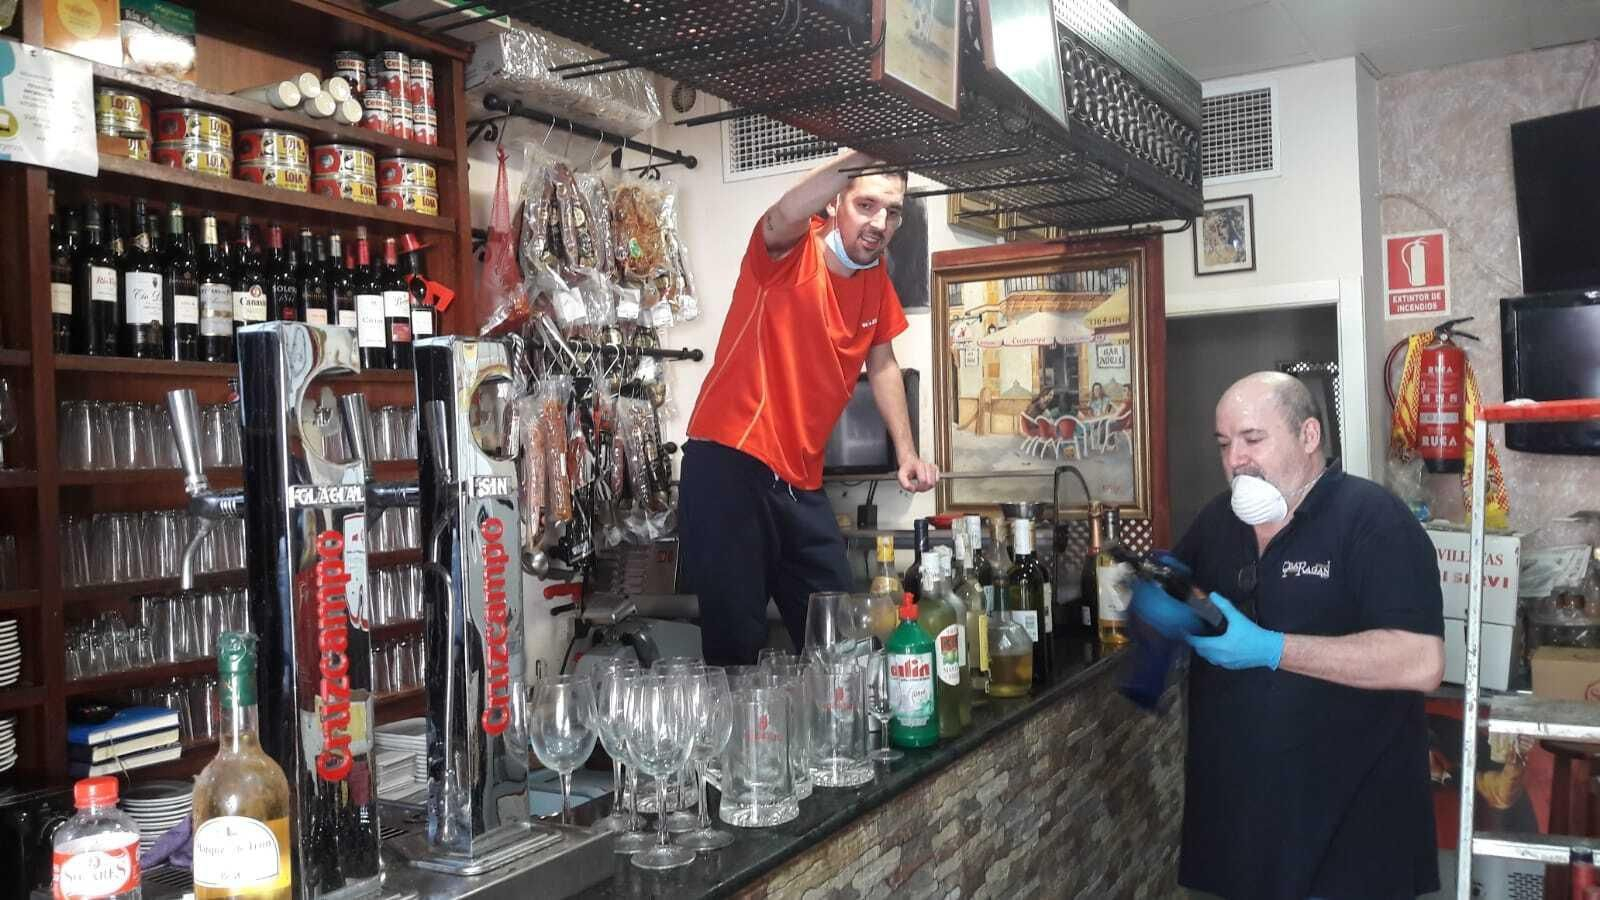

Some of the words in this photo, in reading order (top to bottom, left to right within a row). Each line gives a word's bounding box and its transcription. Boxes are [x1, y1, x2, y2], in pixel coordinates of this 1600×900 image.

[1392, 293, 1430, 304] EXTINTOR
[1431, 291, 1442, 300] DE
[1397, 301, 1438, 312] INCENDIOS
[296, 485, 365, 505] GLACIAL
[481, 517, 511, 736] Cruzcampo
[315, 530, 353, 781] Cruzcampo
